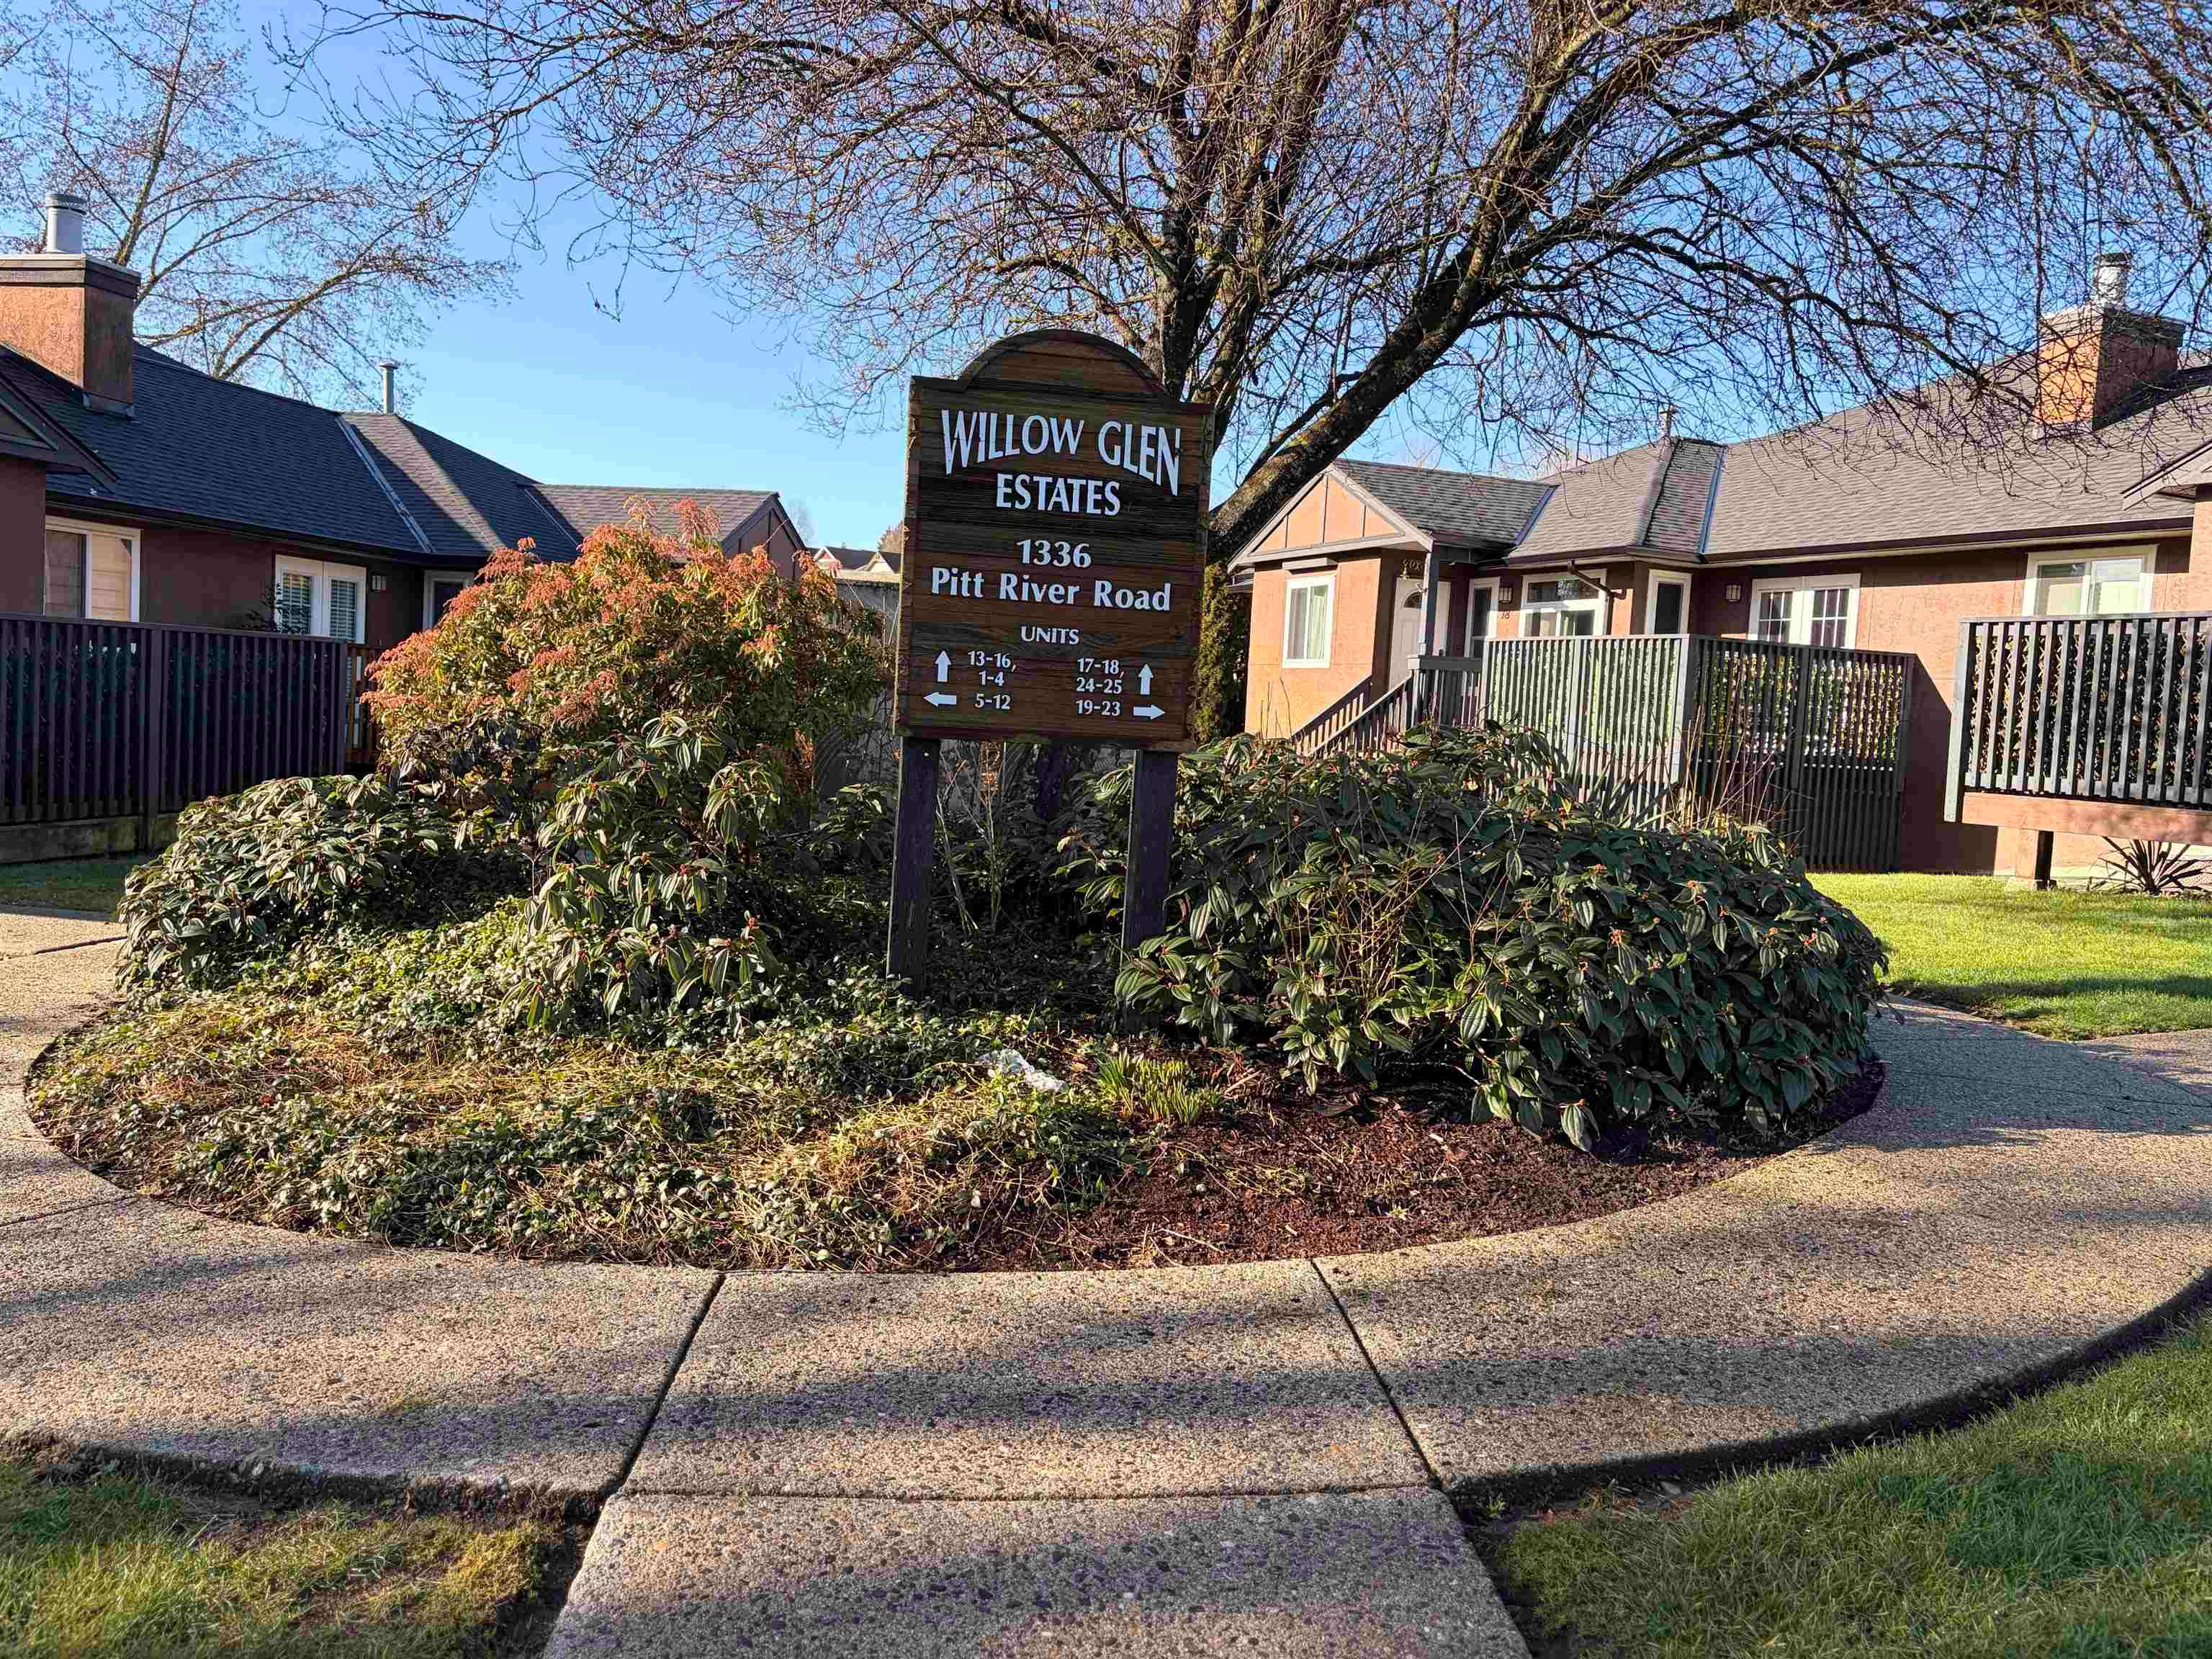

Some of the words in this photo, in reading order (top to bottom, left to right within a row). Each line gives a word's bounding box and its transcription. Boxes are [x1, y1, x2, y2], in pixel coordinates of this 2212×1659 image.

[940, 408, 1085, 476] WILLOW
[1098, 421, 1182, 496] GLEN
[996, 472, 1121, 516] ESTATES
[1016, 539, 1092, 568] 1336
[931, 566, 985, 599] Pitt
[999, 572, 1080, 606] River
[1094, 580, 1172, 611] Road
[1020, 625, 1080, 645] UNITS
[967, 649, 1017, 673] 13-16,
[1077, 657, 1125, 678] 17-18,
[979, 670, 1004, 687] 1-4
[1076, 677, 1123, 695] 24-25
[974, 693, 1012, 710] 5-12
[1075, 699, 1121, 717] 19-23
